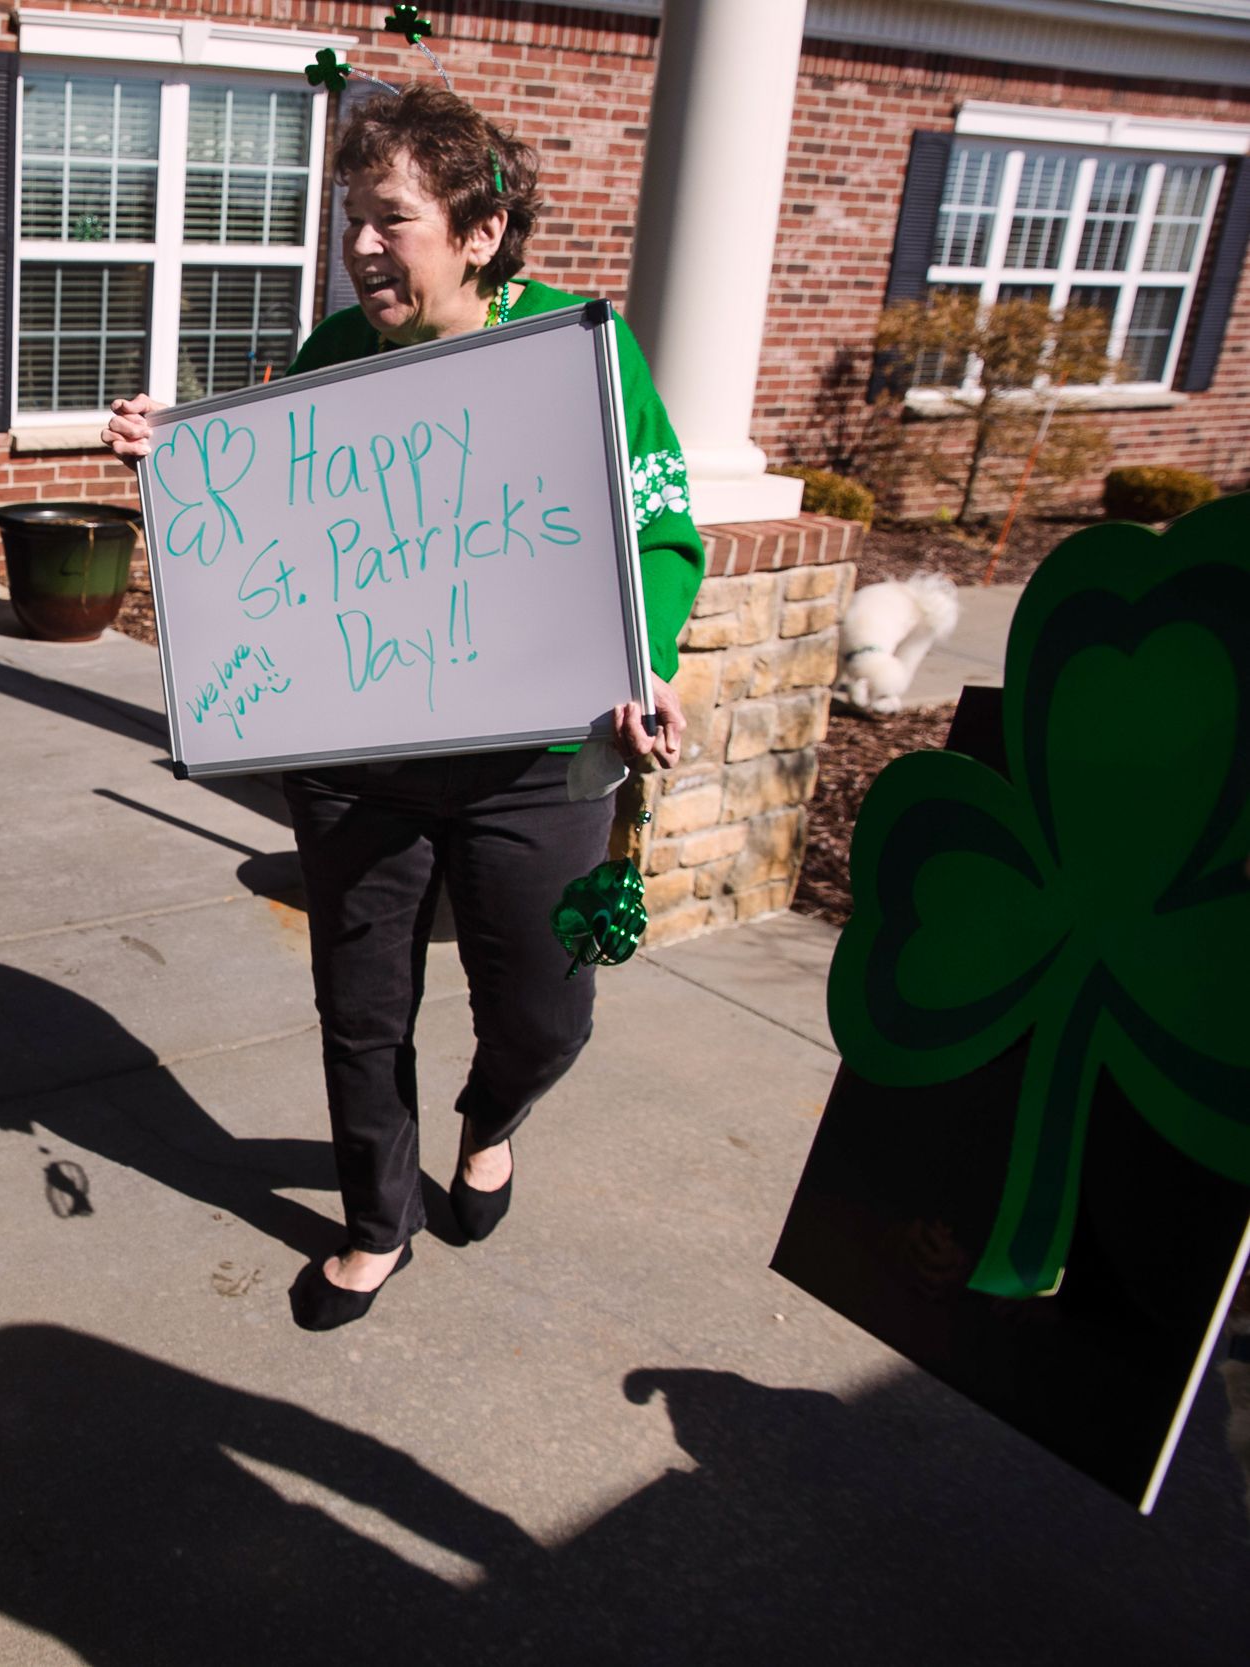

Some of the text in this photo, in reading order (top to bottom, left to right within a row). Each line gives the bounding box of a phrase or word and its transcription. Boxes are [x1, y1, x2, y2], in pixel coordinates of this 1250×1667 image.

[288, 404, 474, 531] Happy
[237, 475, 582, 620] St. Patrick's
[211, 643, 251, 690] love
[336, 580, 479, 713] Day!!
